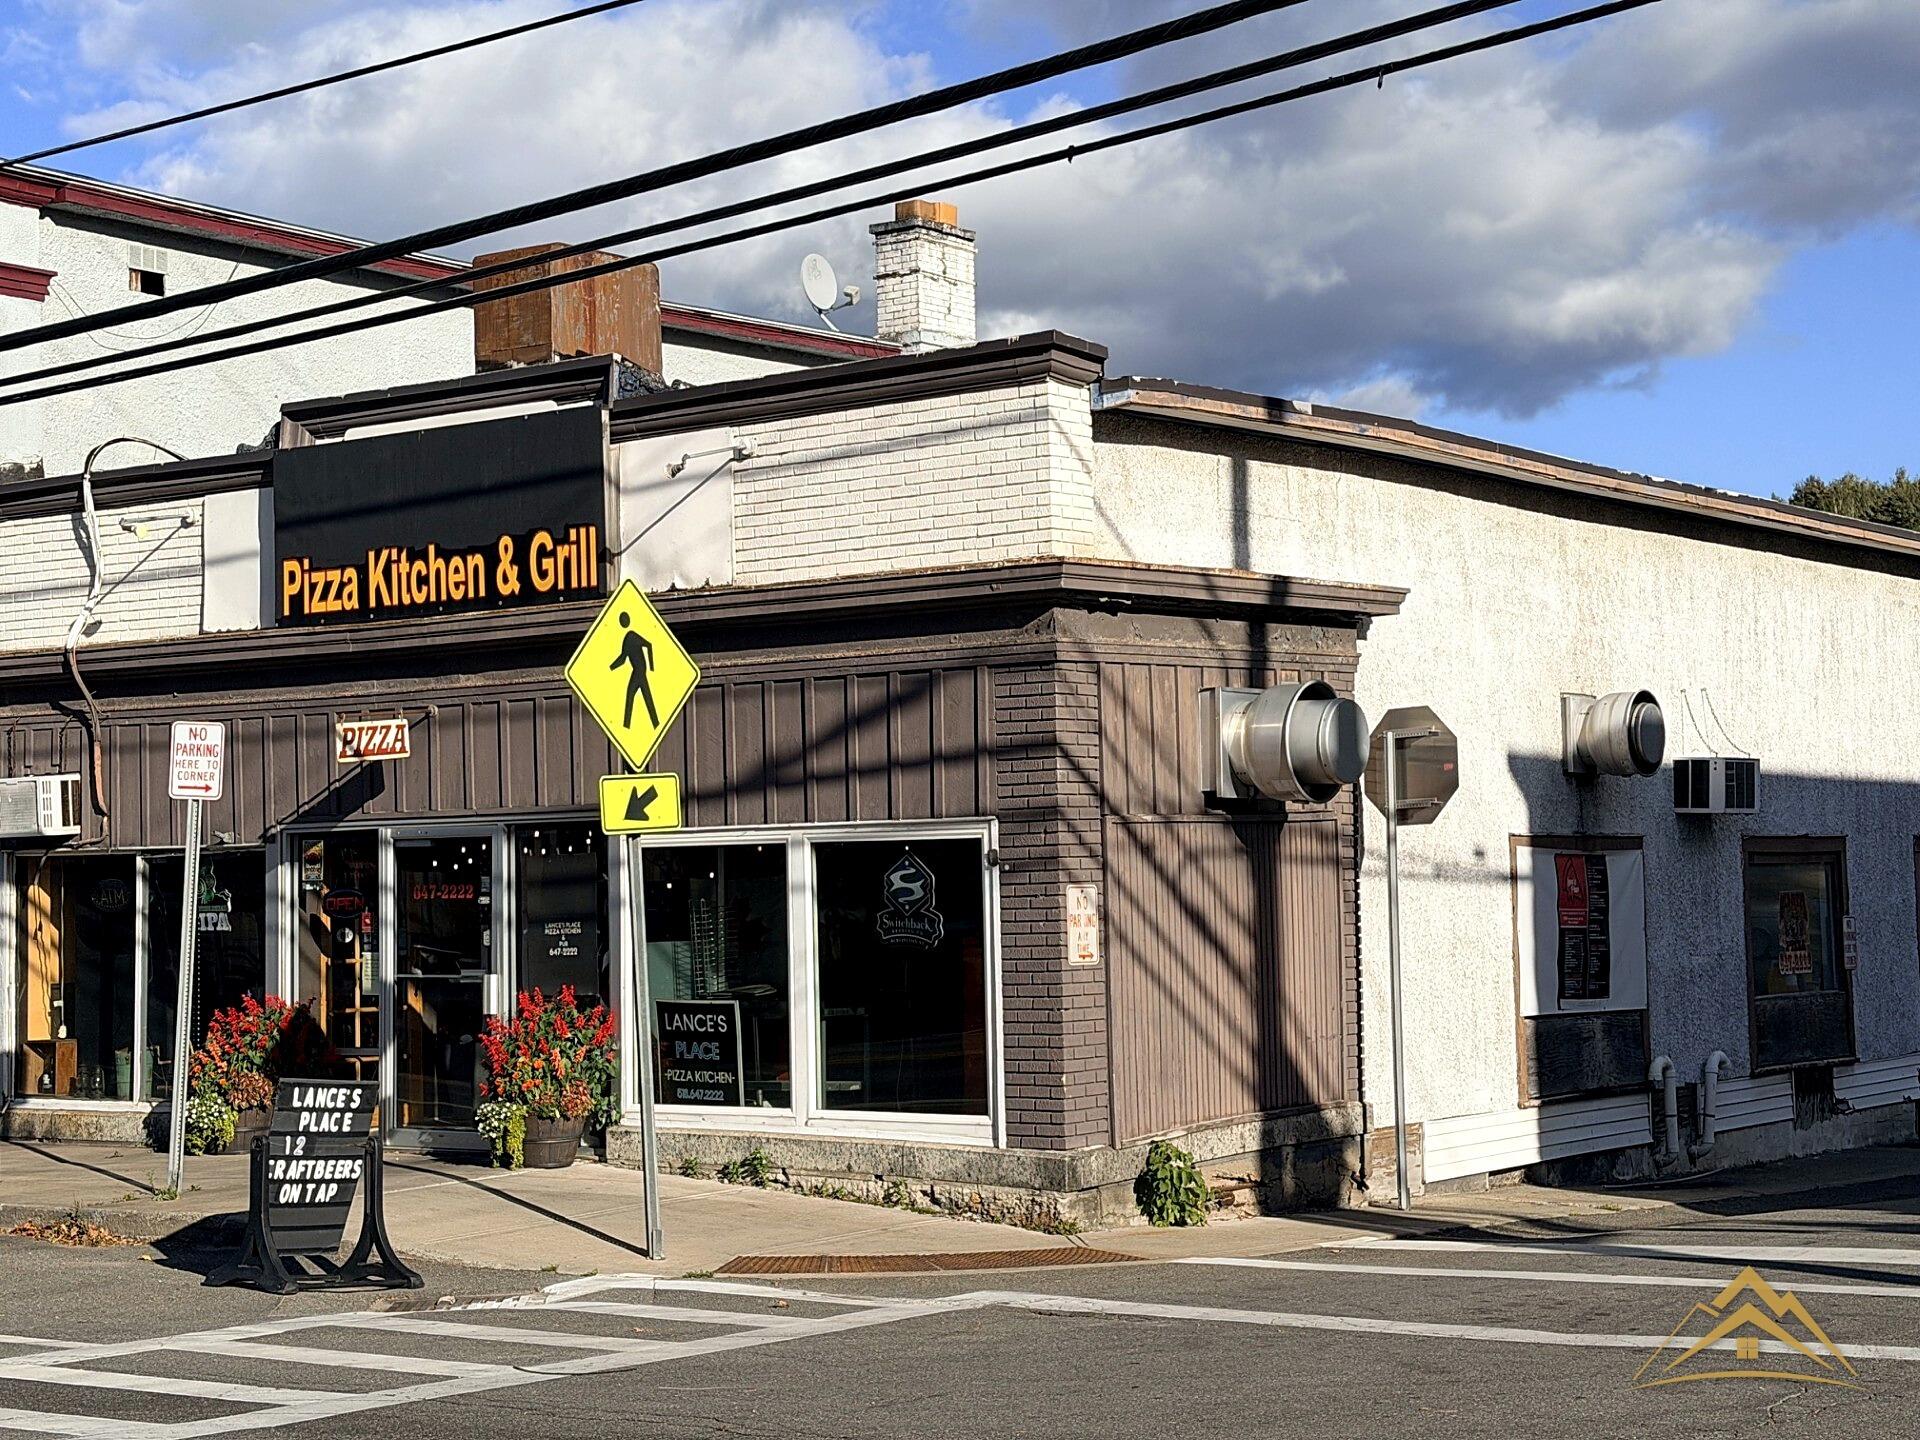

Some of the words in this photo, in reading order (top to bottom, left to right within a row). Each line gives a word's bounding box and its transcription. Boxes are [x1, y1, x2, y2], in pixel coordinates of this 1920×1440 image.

[283, 557, 359, 616] Pizza
[368, 543, 486, 608] Kitchen
[496, 535, 521, 596] &
[529, 526, 598, 592] Grill
[188, 727, 208, 741] NO
[339, 724, 409, 758] PIZZA
[176, 743, 219, 758] PARKING
[175, 759, 200, 769] HERE
[207, 760, 219, 770] TO
[177, 770, 216, 781] CORNER
[326, 897, 365, 911] OPEN
[1076, 896, 1089, 910] NO
[882, 914, 933, 932] Switchback
[1067, 913, 1097, 928] PARING
[664, 1012, 728, 1033] LANCE'S
[675, 1040, 720, 1061] PLACE
[292, 1086, 363, 1109] LANCE'S
[298, 1111, 354, 1132] PLACE
[285, 1135, 307, 1156] 12
[279, 1183, 303, 1204] ON
[305, 1183, 339, 1204] TAP
